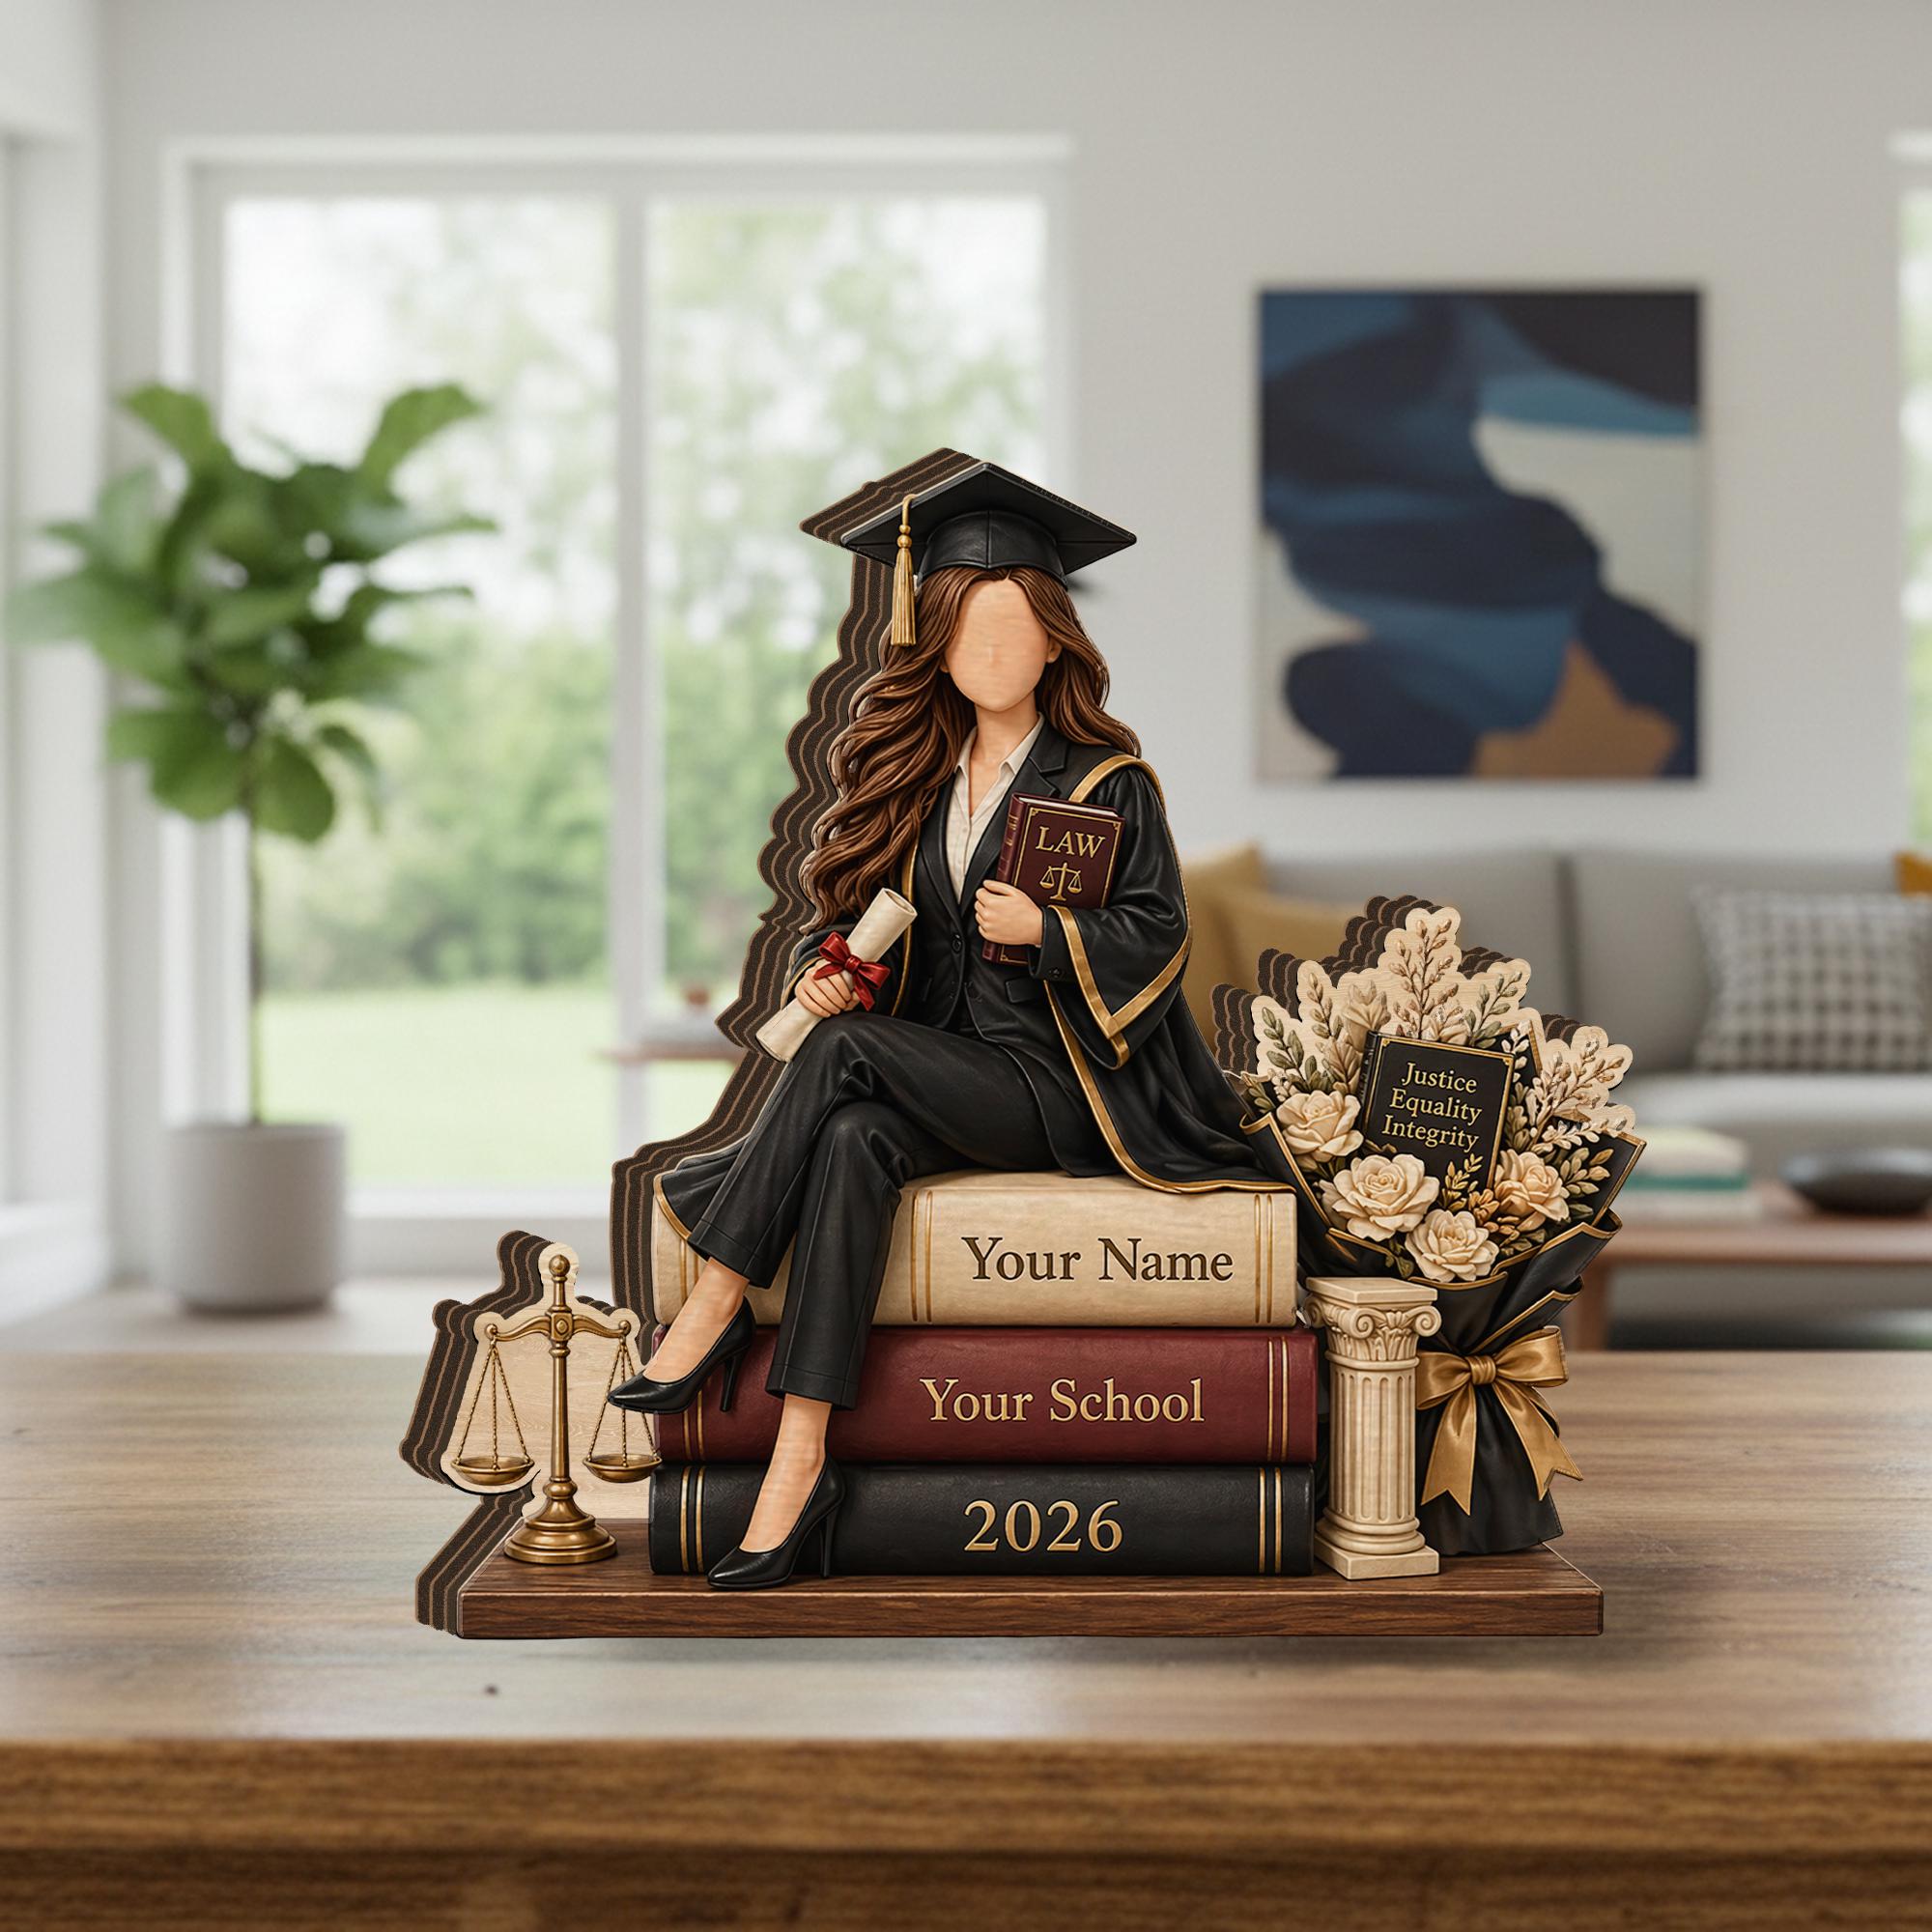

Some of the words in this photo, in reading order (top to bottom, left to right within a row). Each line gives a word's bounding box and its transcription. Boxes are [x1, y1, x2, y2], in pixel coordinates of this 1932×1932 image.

[1036, 826, 1105, 859] LAW
[1401, 1062, 1477, 1094] Justice
[1389, 1088, 1482, 1125] Equality
[1381, 1114, 1479, 1152] Integrity
[961, 1236, 1080, 1281] Your
[1097, 1237, 1234, 1282] Name
[920, 1378, 1034, 1422] Your
[1049, 1378, 1205, 1422] School
[963, 1499, 1122, 1552] 2026
